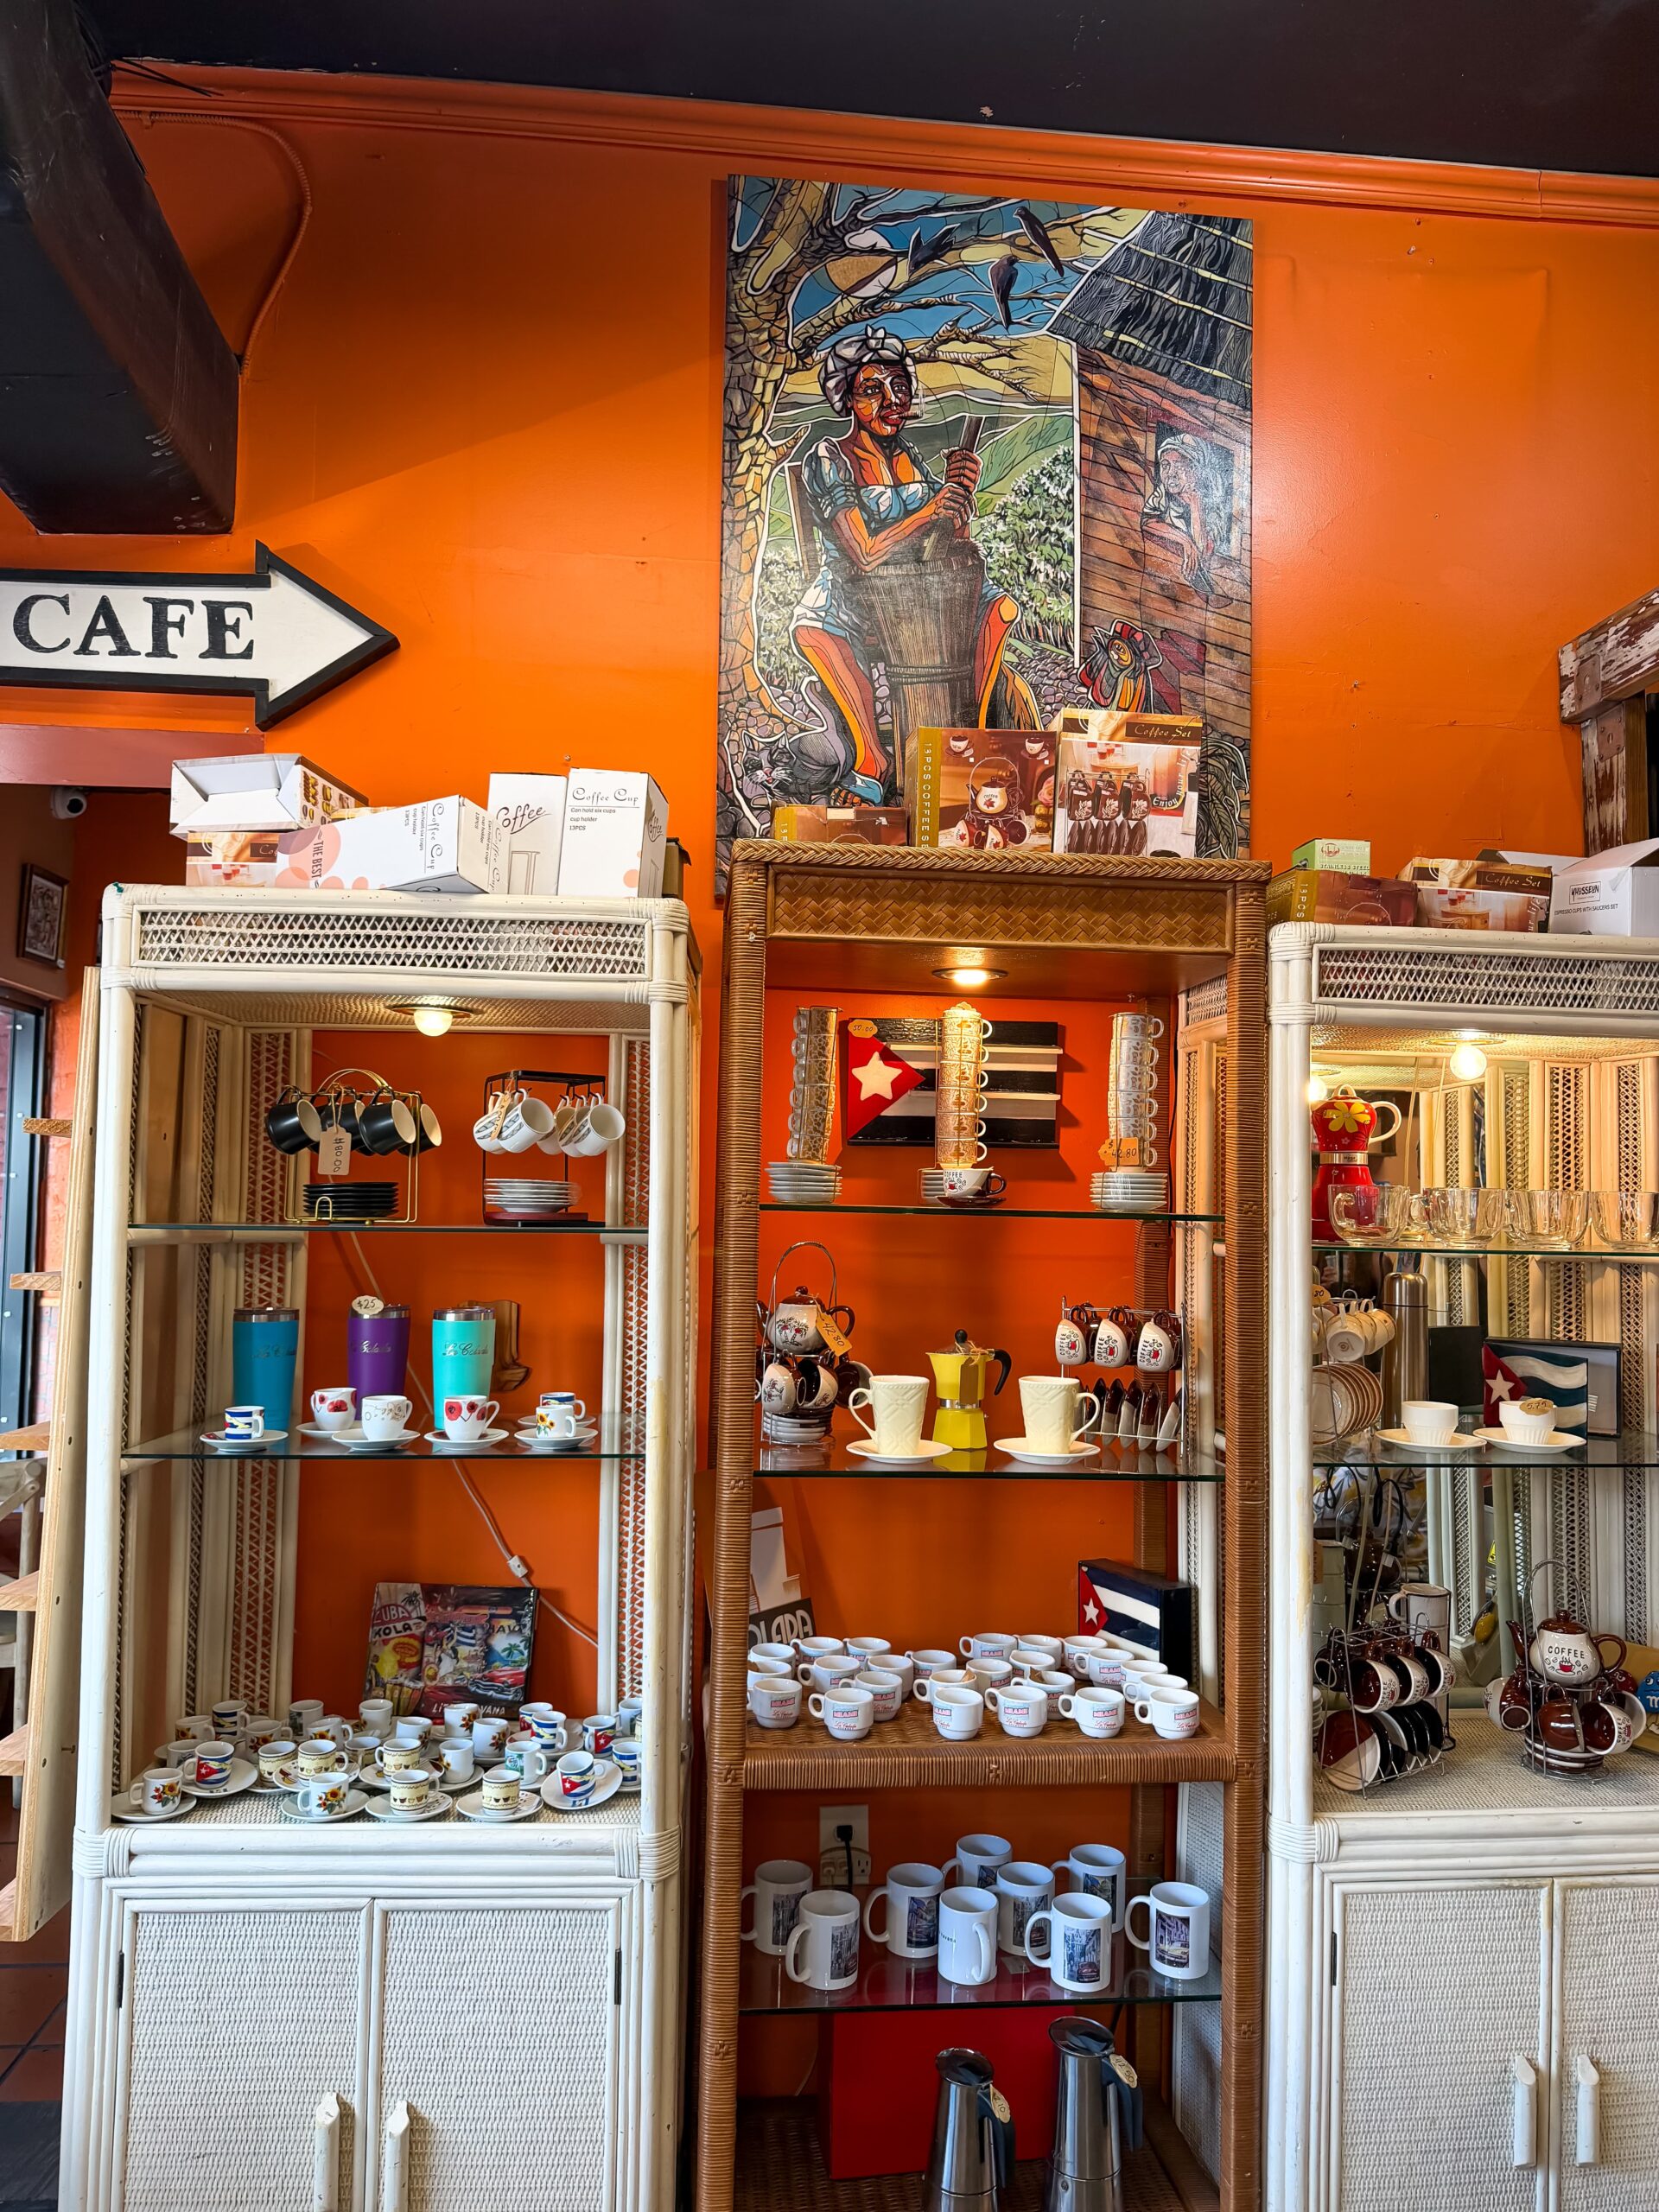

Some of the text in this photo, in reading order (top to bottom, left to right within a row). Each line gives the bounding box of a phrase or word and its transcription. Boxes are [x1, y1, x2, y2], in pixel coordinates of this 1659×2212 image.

[12, 594, 254, 660] CAFE
[1134, 724, 1192, 738] Coffee Set
[572, 787, 639, 806] Coffee Cup
[921, 743, 932, 849] 13PCS COFFEE SE
[1153, 796, 1178, 810] Enjoy
[427, 803, 444, 841] Coffee
[496, 804, 550, 835] Coffee
[311, 840, 324, 879] THE BEST
[426, 844, 442, 869] Cup
[1485, 873, 1541, 887] Coffee Set
[1296, 883, 1308, 918] 13PCS
[1111, 1147, 1137, 1159] 42.80
[357, 1298, 378, 1309] $25
[1096, 1337, 1105, 1361] COFFEE
[1139, 1339, 1150, 1363] COFFEE
[373, 1605, 410, 1624] CUBA
[373, 1622, 413, 1639] KOLA
[1548, 1645, 1586, 1659] COFFEE
[833, 1709, 859, 1719] MIAMI
[1004, 1707, 1029, 1715] MIAMI
[1092, 1708, 1118, 1719] MIAMI
[1173, 1708, 1198, 1720] MIAMI
